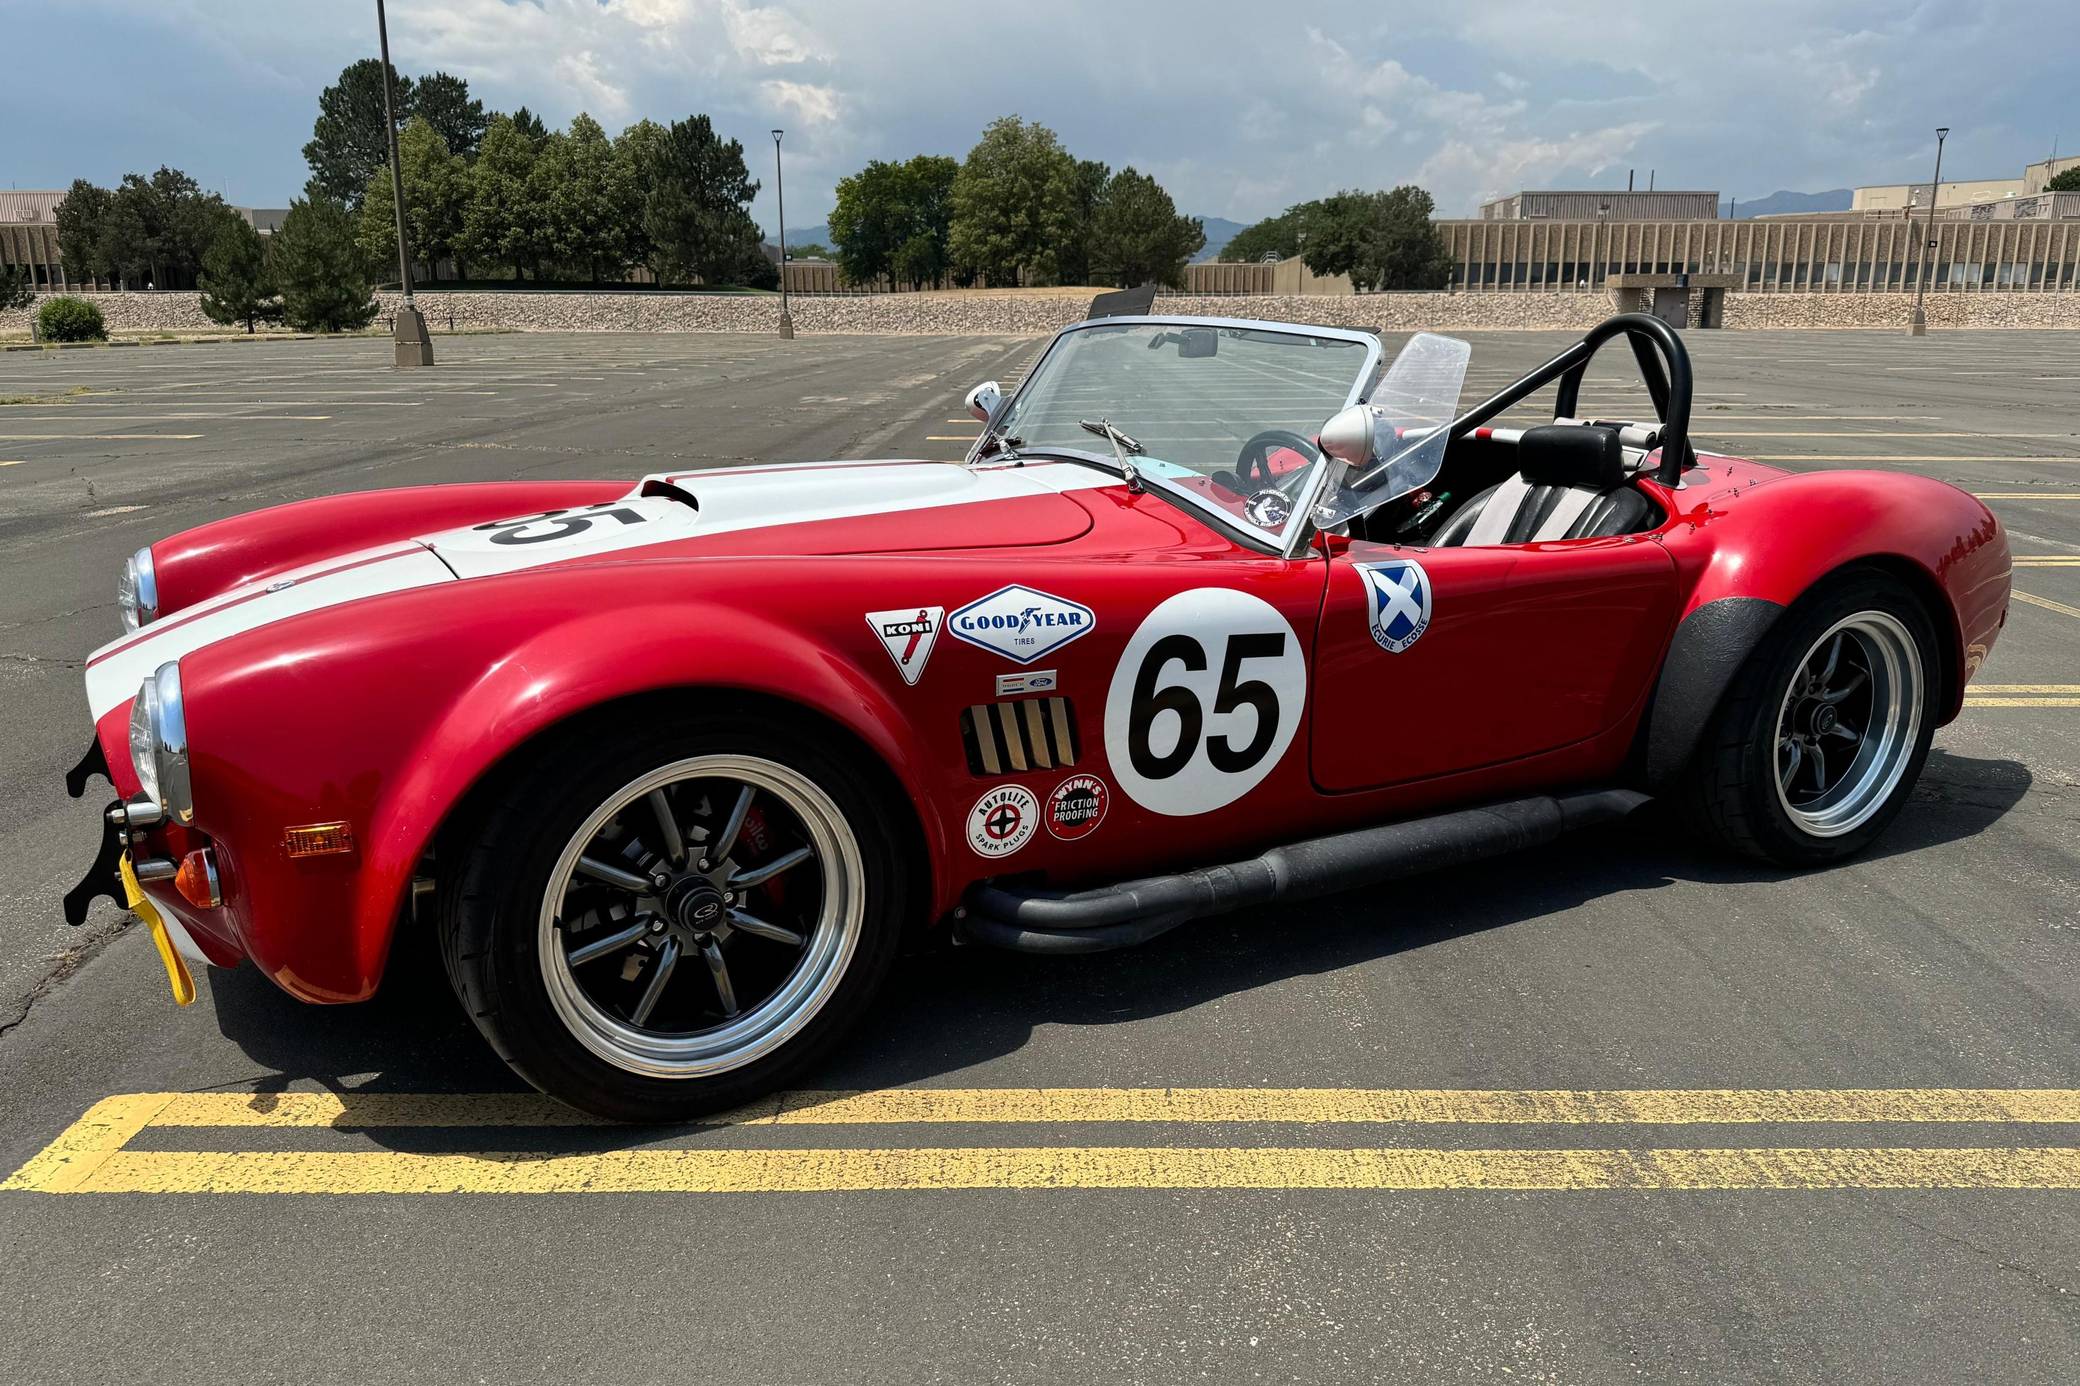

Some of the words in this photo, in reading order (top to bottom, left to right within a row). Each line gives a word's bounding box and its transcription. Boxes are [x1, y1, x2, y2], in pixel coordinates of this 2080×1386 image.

[886, 622, 930, 635] KONI
[1371, 623, 1396, 650] ECURIE
[1401, 617, 1428, 648] ECOSSE
[1014, 637, 1036, 646] TIRES
[1129, 633, 1286, 780] 65
[1053, 778, 1103, 801] WYNN'S
[978, 791, 1031, 816] AUTOLITE
[1053, 807, 1099, 822] PROOFING
[1054, 797, 1100, 812] FRICTION
[975, 833, 1000, 851] SPARK
[1003, 824, 1029, 849] PLUGS
